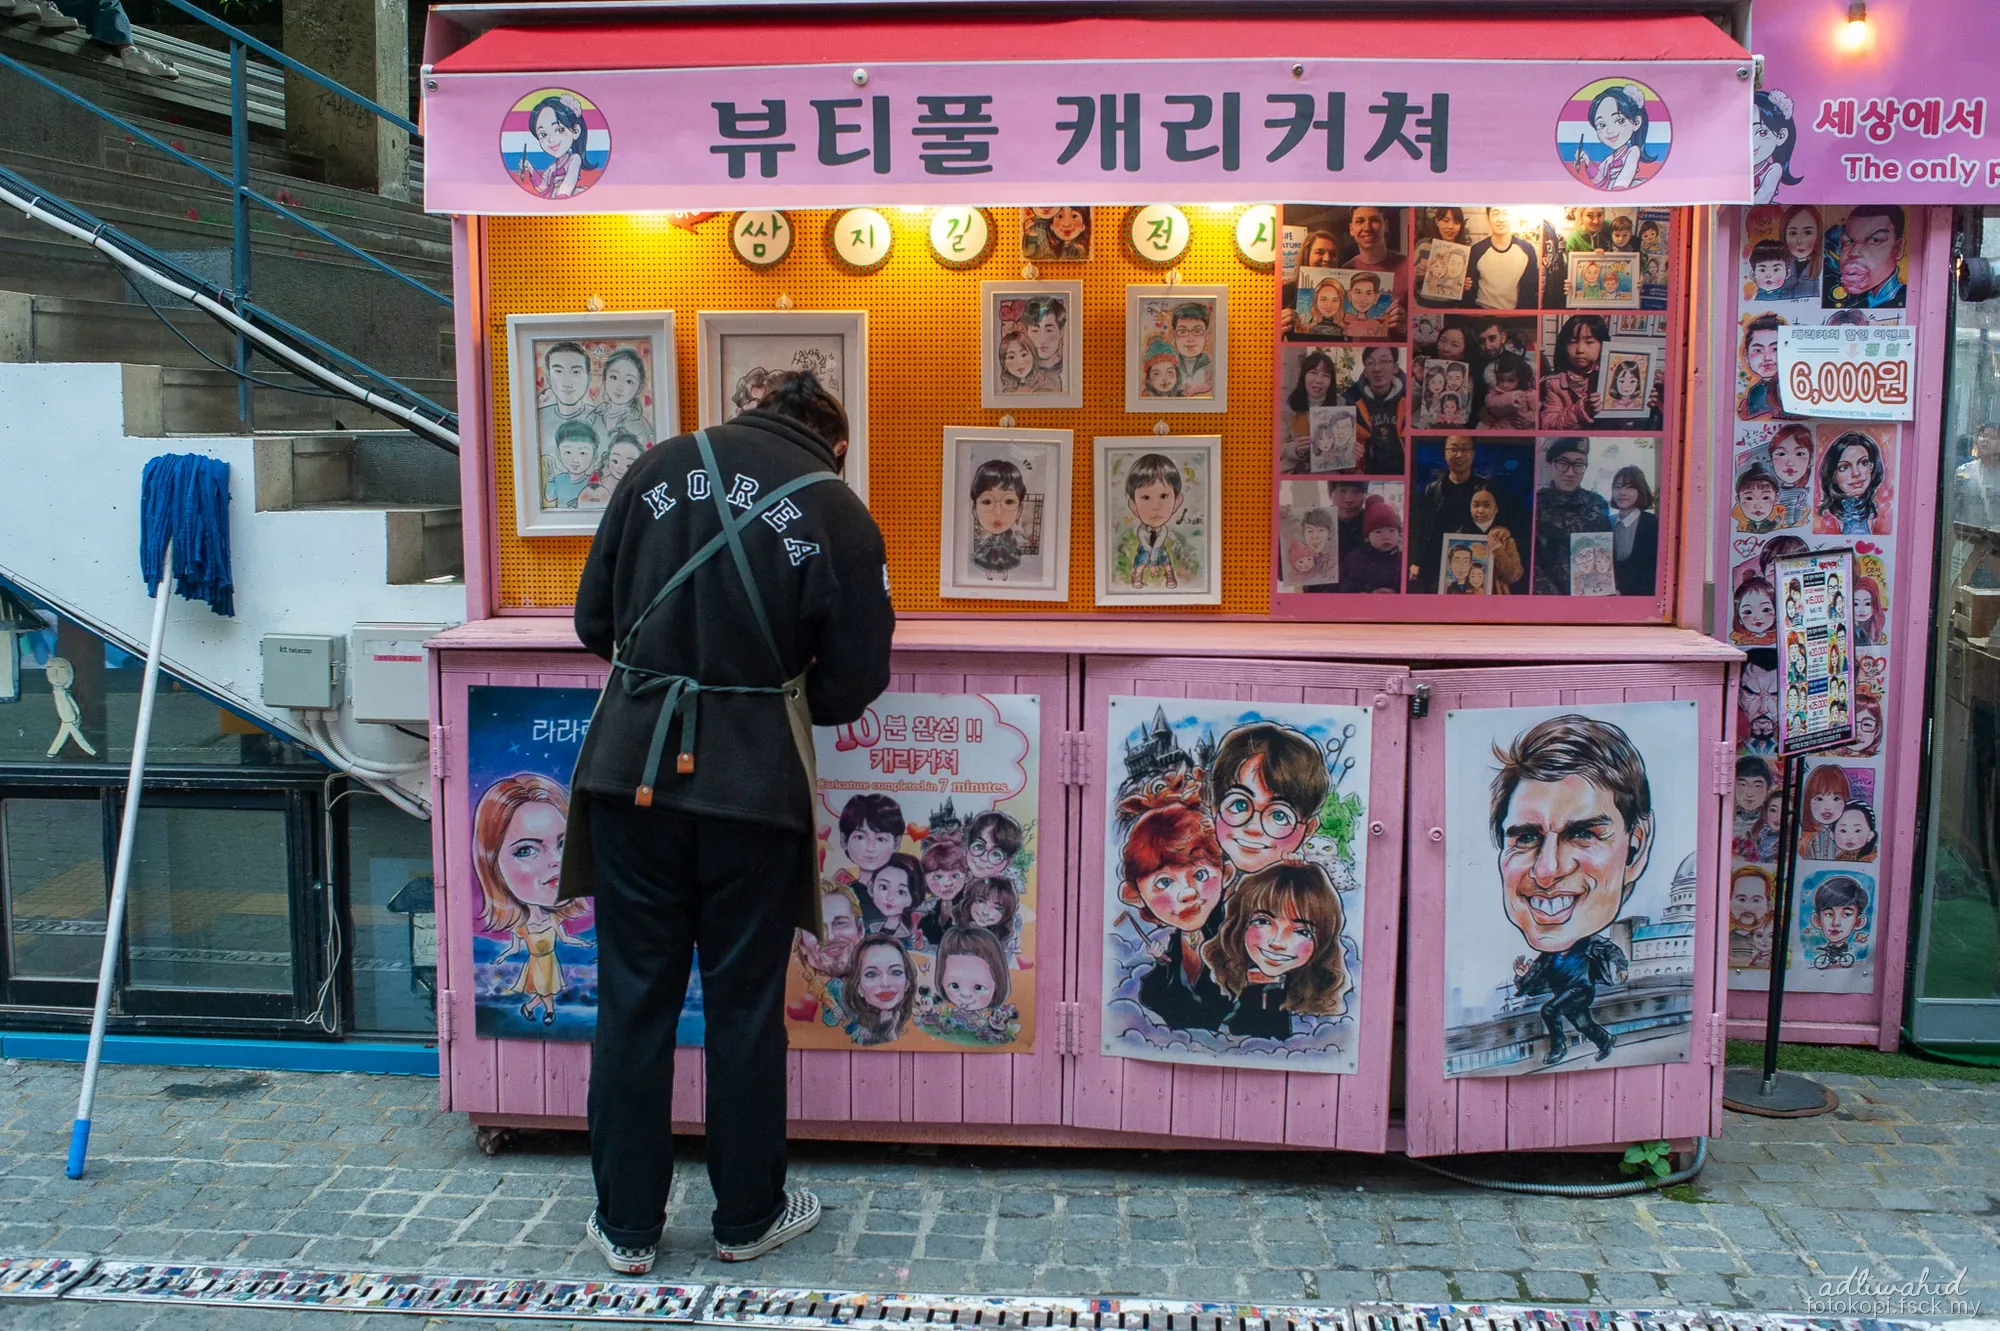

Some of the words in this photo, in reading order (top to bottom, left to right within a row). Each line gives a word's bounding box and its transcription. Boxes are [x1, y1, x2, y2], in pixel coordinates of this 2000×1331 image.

[709, 95, 999, 179] 뷰티풀
[1055, 91, 1450, 174] 캐리커쳐
[1814, 98, 1985, 143] 세상에서
[1842, 154, 1901, 181] The
[1907, 154, 1979, 187] only
[1790, 360, 1907, 405] 6,000원
[642, 469, 820, 566] KOREA
[279, 645, 287, 653] kt
[912, 716, 959, 743] 완성
[816, 778, 870, 790] Caricature
[871, 779, 925, 792] completed
[938, 778, 949, 793] 7
[951, 779, 1011, 793] minutes.
